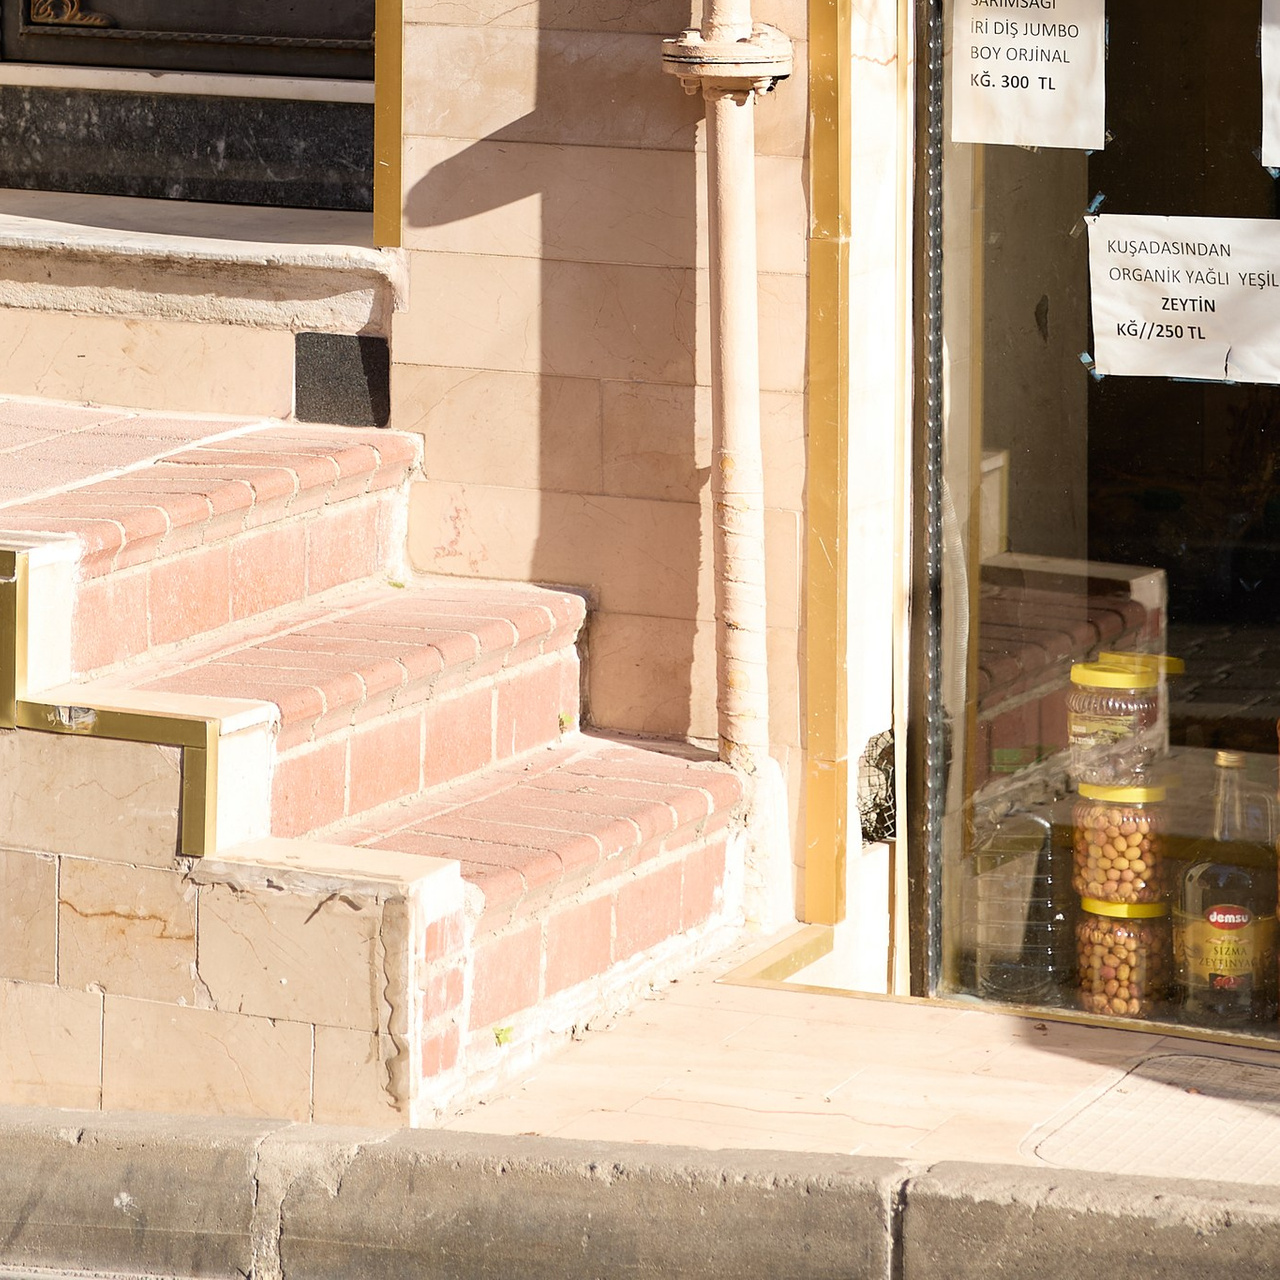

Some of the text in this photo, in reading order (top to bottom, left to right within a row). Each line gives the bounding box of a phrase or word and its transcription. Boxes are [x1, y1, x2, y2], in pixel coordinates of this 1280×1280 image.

[970, 17, 1080, 39] İRİ DİŞ JUMBO
[970, 45, 1071, 64] BOY ORJİNAL
[970, 70, 1056, 91] KĞ. 300 TL
[1107, 239, 1231, 258] KUŞADASINDAN
[1109, 266, 1280, 290] ORGANİK YAĞLI YEŞİL
[1161, 296, 1216, 313] ZEYTİN
[1116, 319, 1206, 340] KĞ//250 TL
[1209, 911, 1249, 923] demsu
